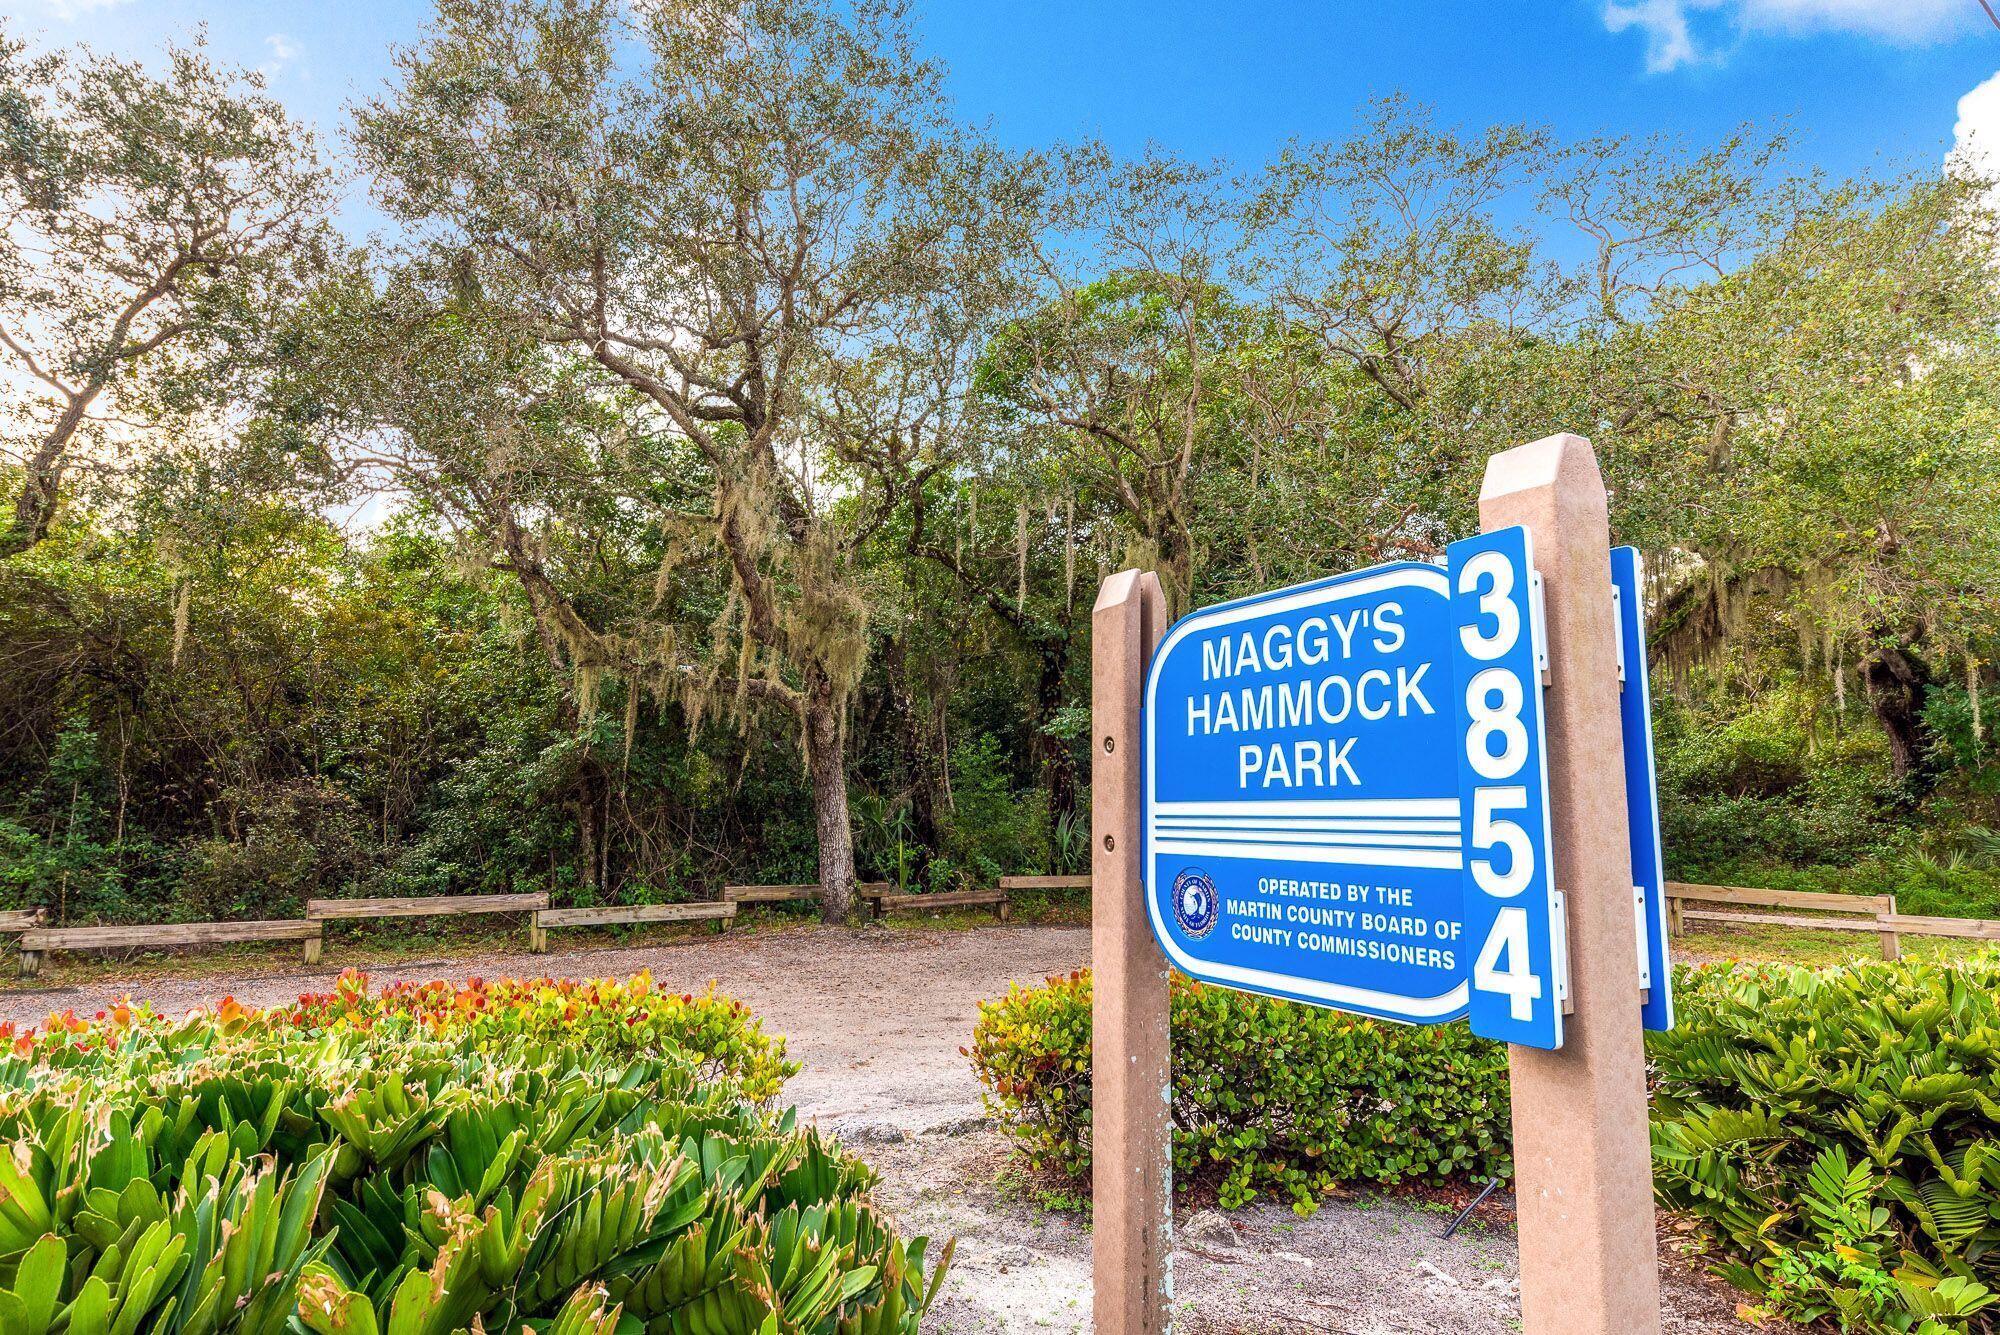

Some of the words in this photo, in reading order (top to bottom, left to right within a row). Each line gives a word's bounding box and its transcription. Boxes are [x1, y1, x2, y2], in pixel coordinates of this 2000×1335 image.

[1202, 601, 1406, 681] MAGGY'S
[1187, 662, 1436, 737] HAMMOCK
[1239, 737, 1362, 789] PARK
[1458, 550, 1542, 1022] 3854
[1258, 877, 1342, 900] OPERATED
[1347, 884, 1370, 903] BY
[1375, 886, 1413, 907] THE
[1226, 898, 1282, 921] MARTIN
[1286, 905, 1356, 929] COUNTY
[1361, 912, 1428, 937] BOARD
[1434, 920, 1463, 941] OF
[1231, 923, 1293, 947] COUNTY
[1297, 931, 1456, 970] COMMISSIONERS
